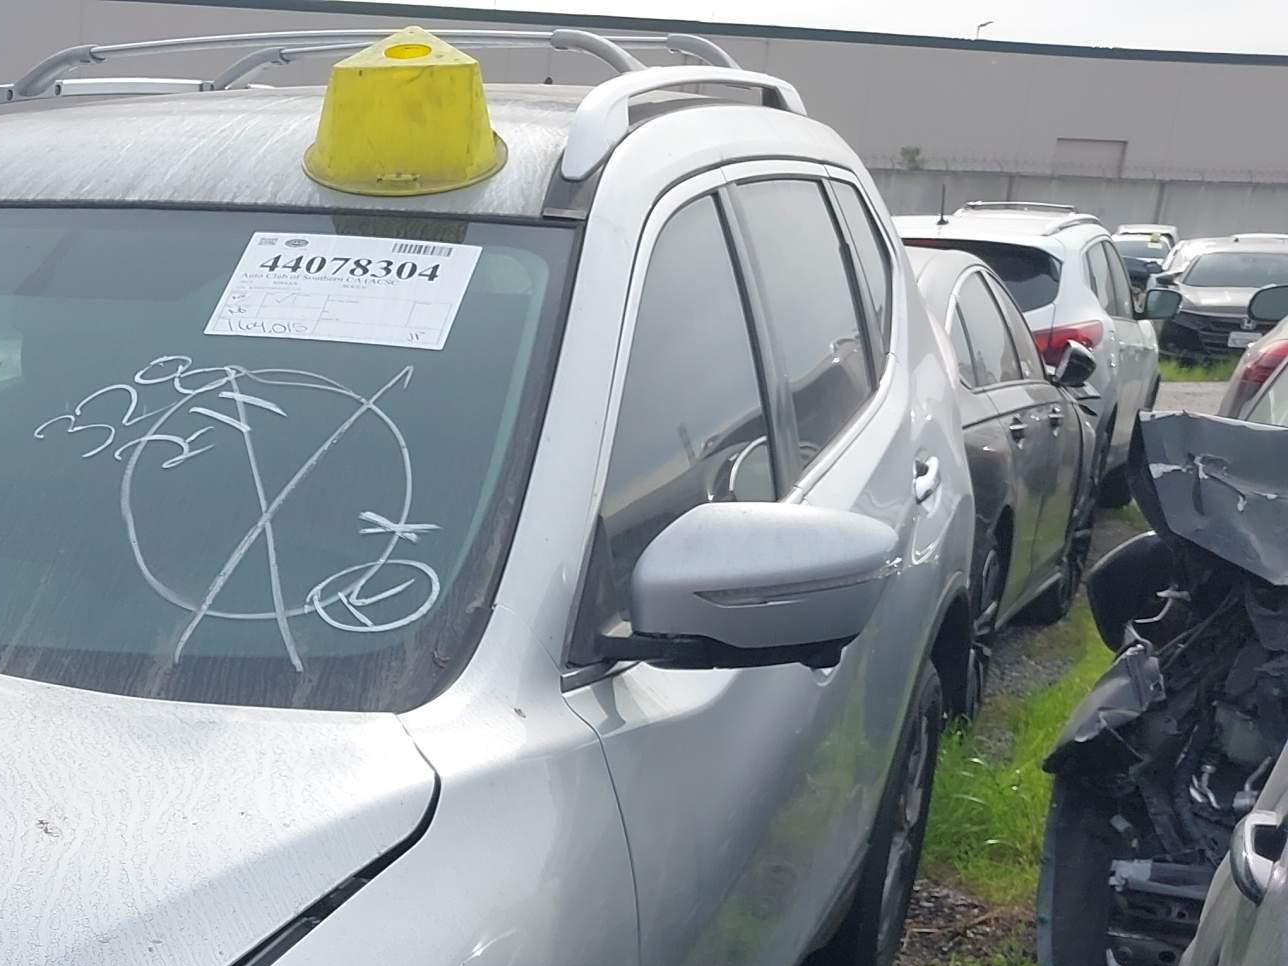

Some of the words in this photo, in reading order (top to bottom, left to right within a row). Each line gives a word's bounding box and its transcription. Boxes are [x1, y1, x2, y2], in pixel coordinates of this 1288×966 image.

[259, 253, 441, 282] 44078304
[265, 272, 287, 280] Club
[303, 274, 344, 283] Southern
